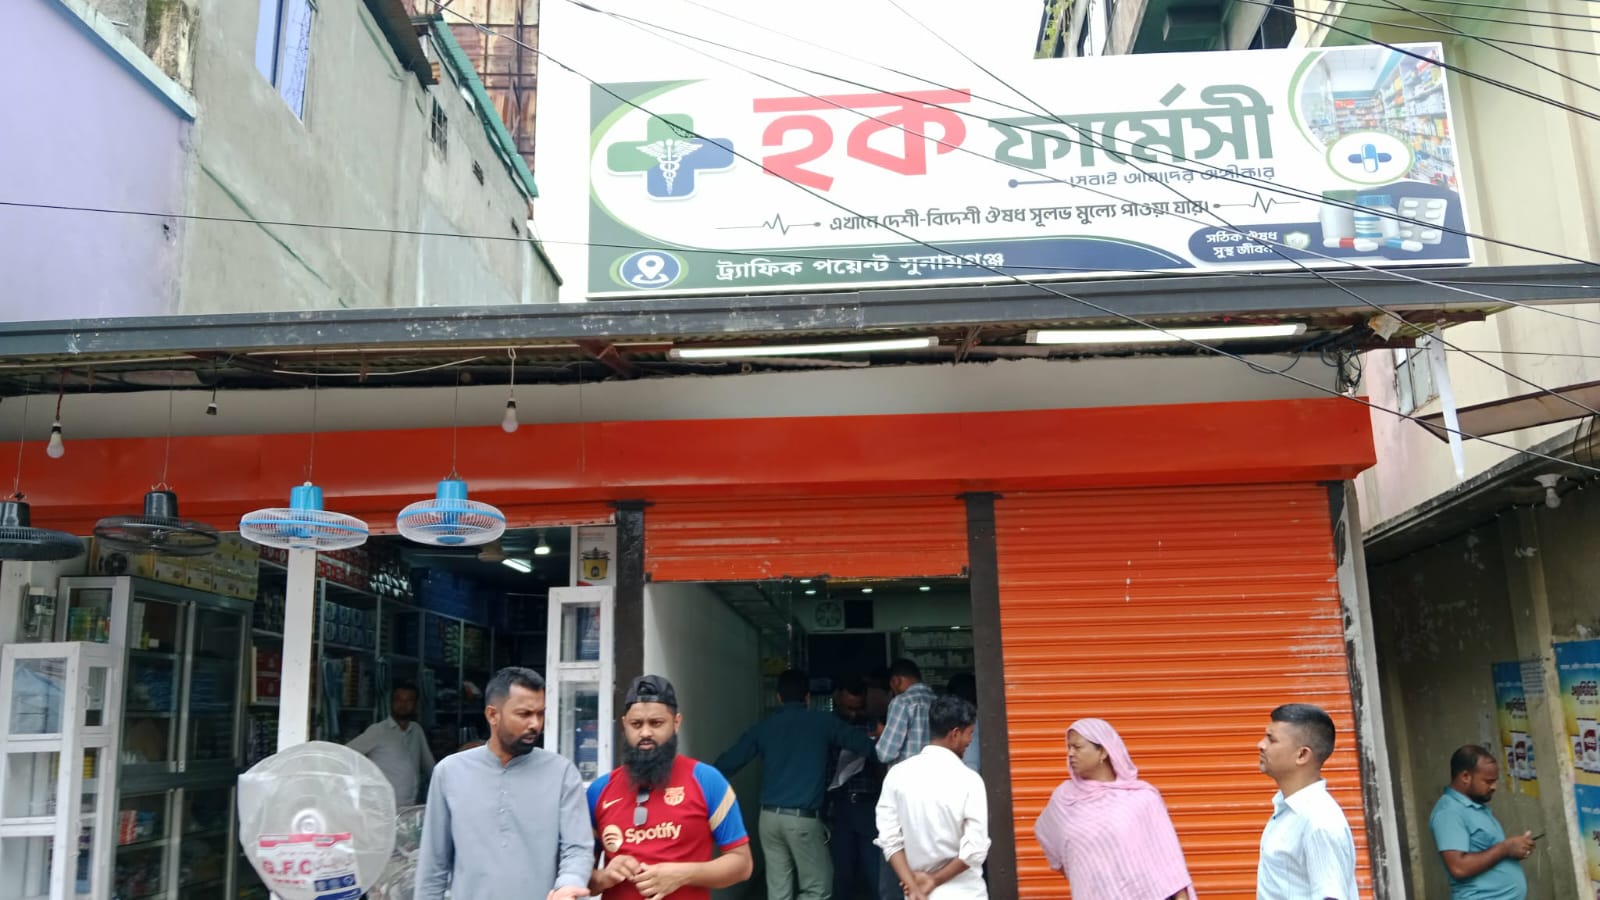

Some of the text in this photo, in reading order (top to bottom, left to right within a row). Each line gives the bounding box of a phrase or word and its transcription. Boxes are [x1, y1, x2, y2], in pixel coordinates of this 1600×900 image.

[753, 83, 1274, 192] হক ফার্মেসী
[883, 205, 981, 228] দেশী-বিদেশী
[985, 206, 1026, 224] ঔষধ
[1121, 201, 1169, 218] পাওয়া
[812, 254, 889, 275] পয়েন্ট
[624, 821, 682, 845] Spotify
